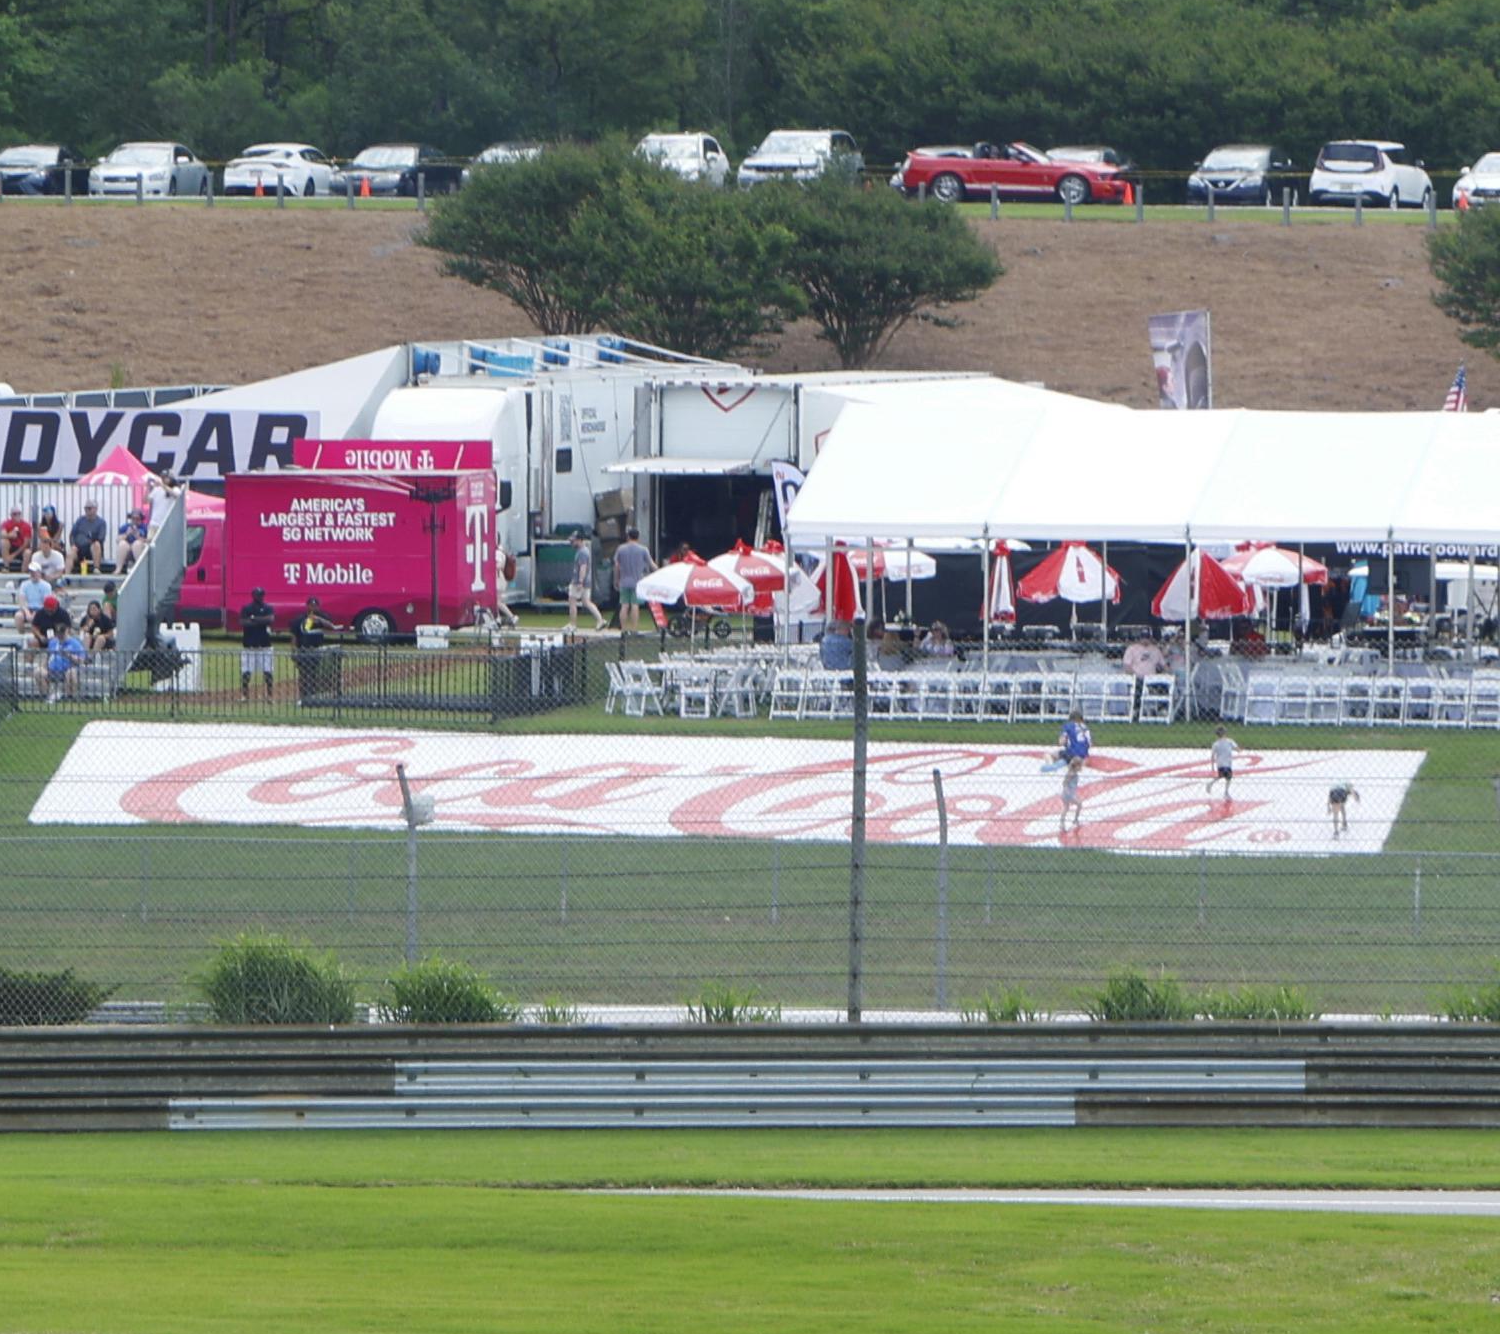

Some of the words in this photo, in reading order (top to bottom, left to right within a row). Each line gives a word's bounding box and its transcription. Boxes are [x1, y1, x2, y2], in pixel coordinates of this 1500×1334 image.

[345, 449, 413, 470] Mobile
[290, 498, 365, 513] AMERICA'S
[260, 512, 325, 527] LARGEST
[325, 513, 335, 527] &
[337, 512, 396, 527] FASTEST
[282, 527, 302, 542] 5G
[304, 527, 374, 542] NETWORK
[306, 563, 373, 585] Mobile
